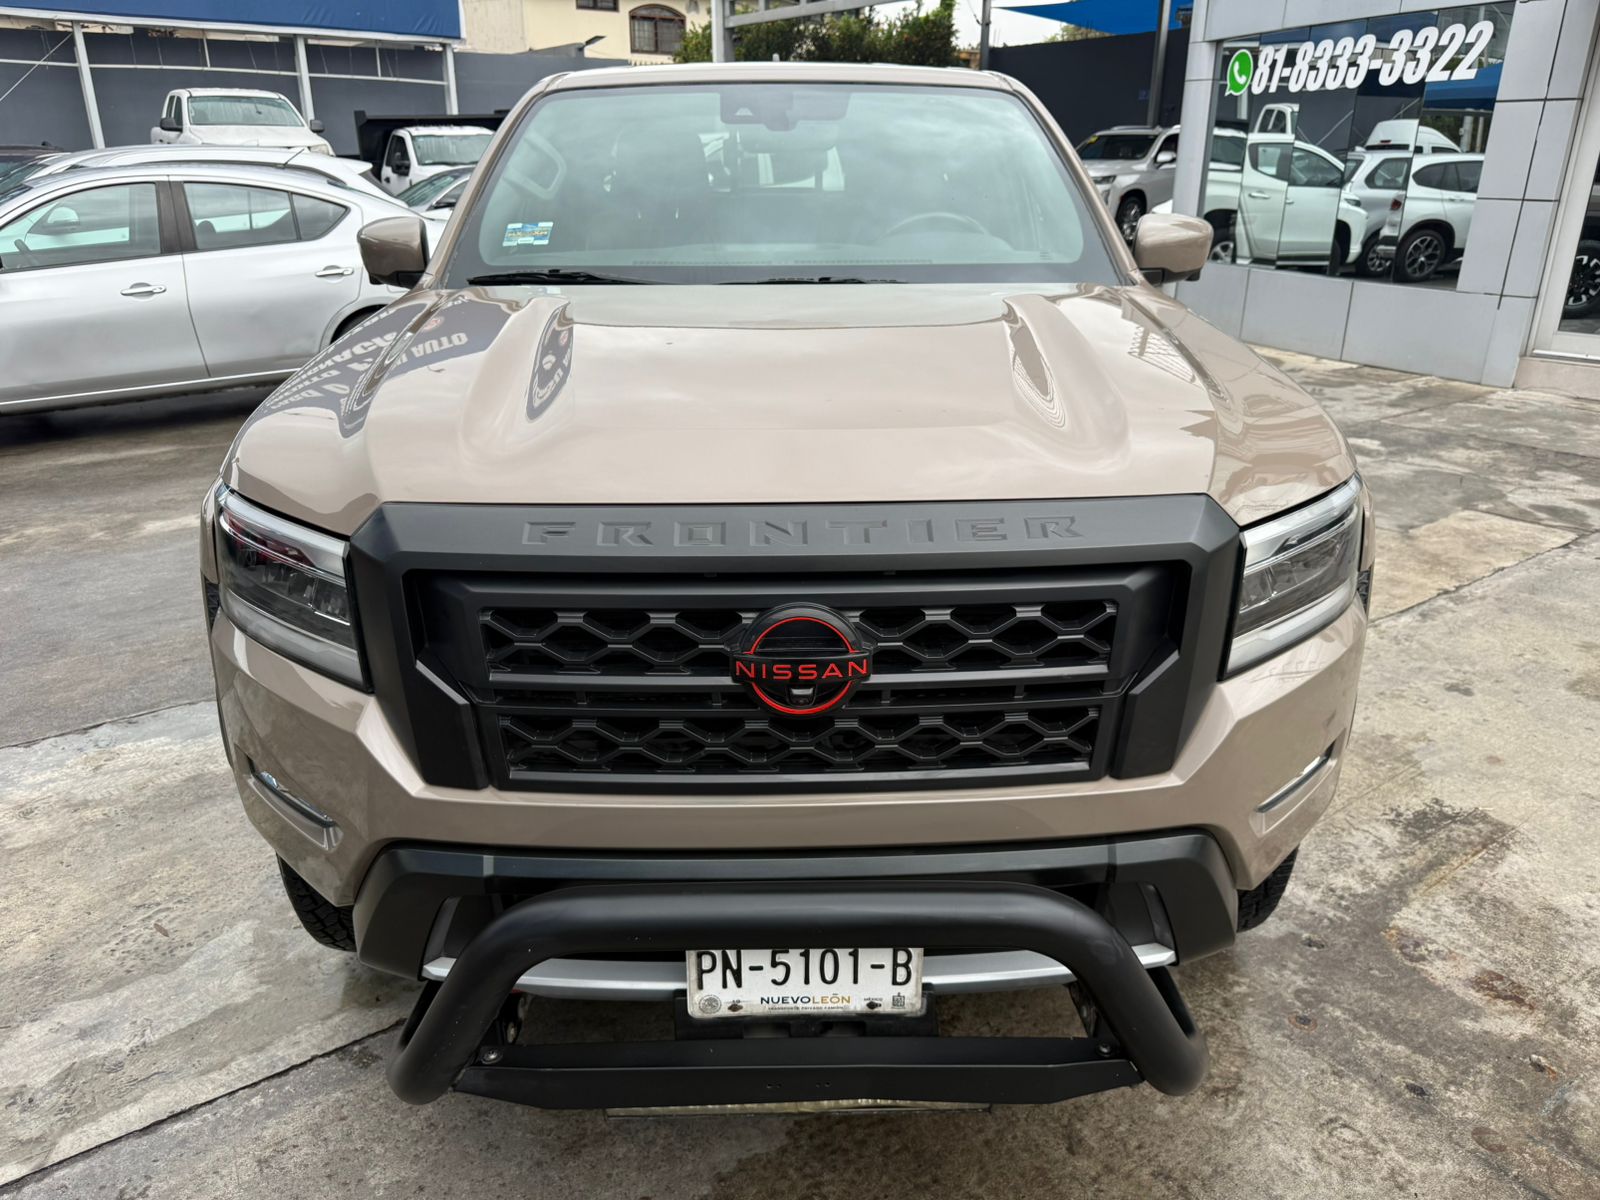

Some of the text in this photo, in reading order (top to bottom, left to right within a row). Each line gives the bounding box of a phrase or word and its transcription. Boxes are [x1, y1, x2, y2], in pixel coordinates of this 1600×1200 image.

[1251, 20, 1494, 95] 81-8333-3322
[521, 514, 1085, 547] FRONTIER
[735, 658, 868, 680] NISSAN
[697, 948, 913, 990] PN-5101-B
